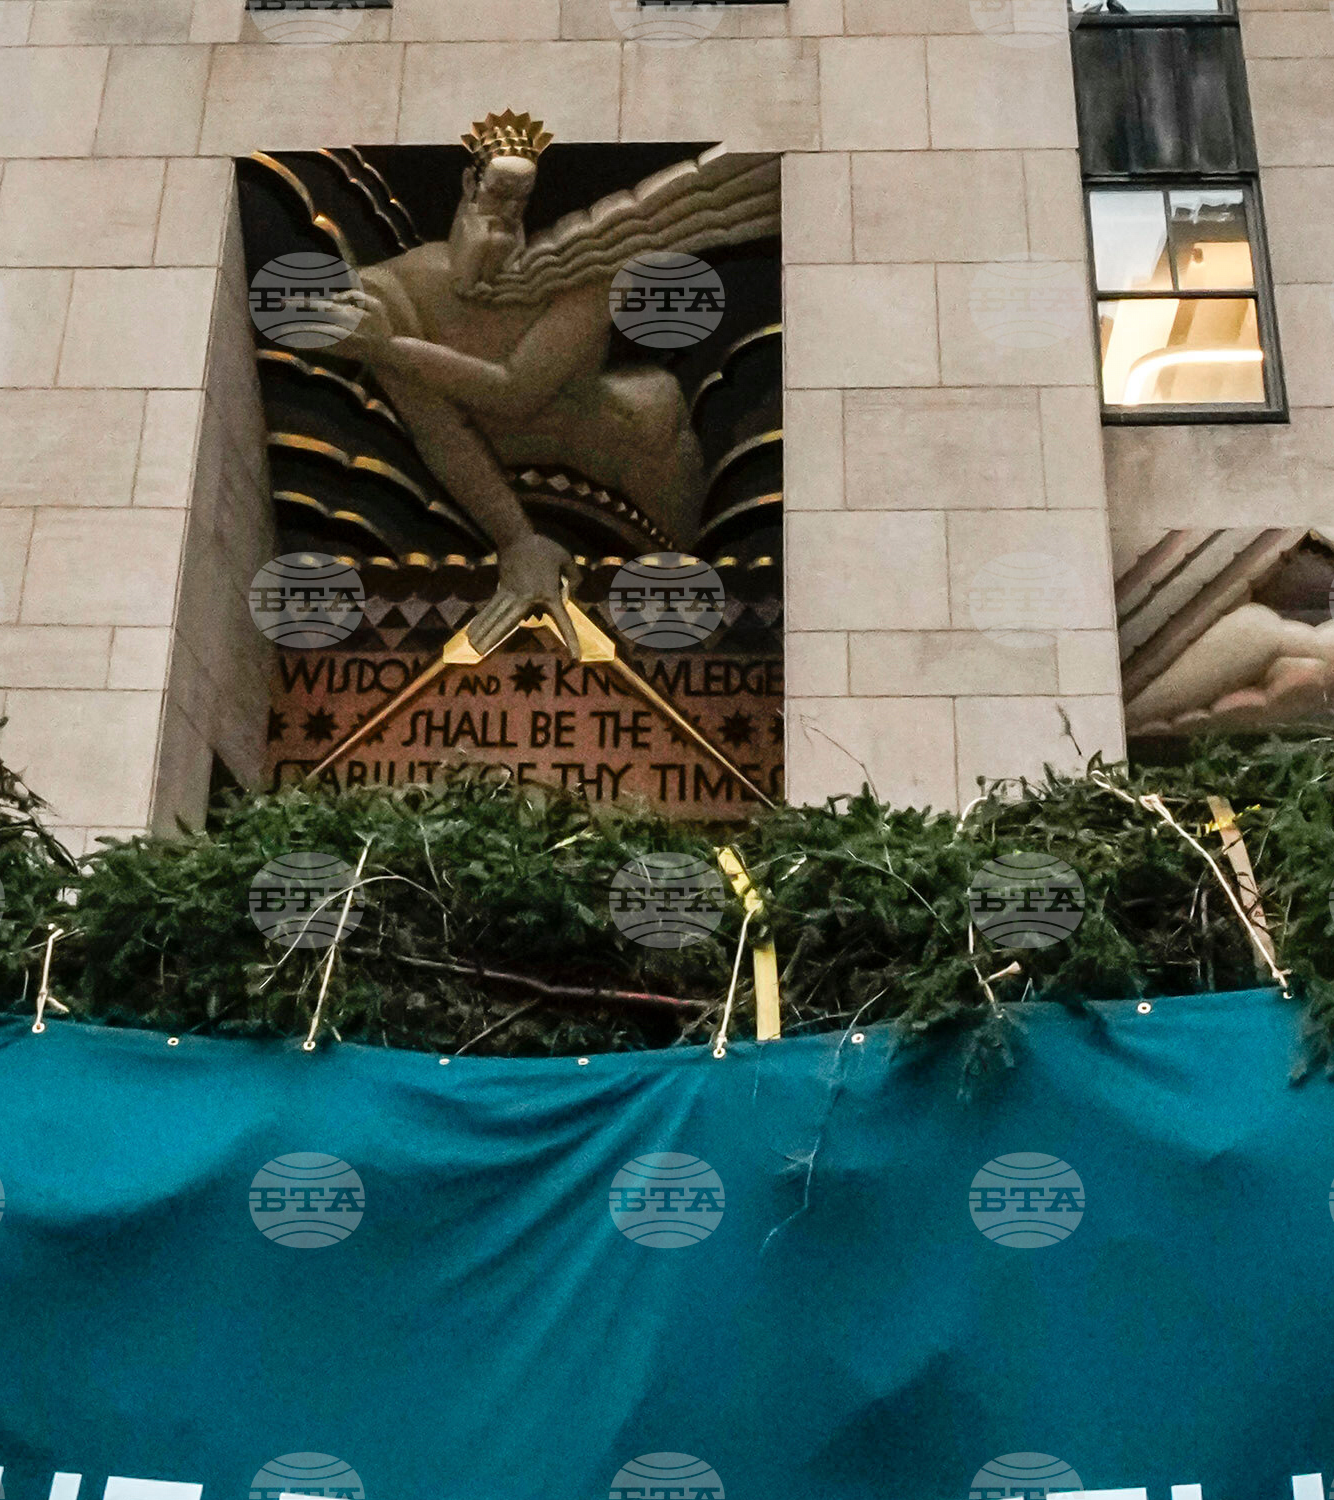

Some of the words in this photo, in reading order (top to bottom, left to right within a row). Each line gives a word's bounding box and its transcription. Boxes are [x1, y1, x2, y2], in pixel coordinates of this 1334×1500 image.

[455, 674, 500, 696] AND
[555, 658, 785, 697] KNWLEDGE
[401, 709, 518, 748] SHALL
[530, 710, 575, 748] BE
[589, 710, 652, 748] THE
[551, 762, 633, 801] THY
